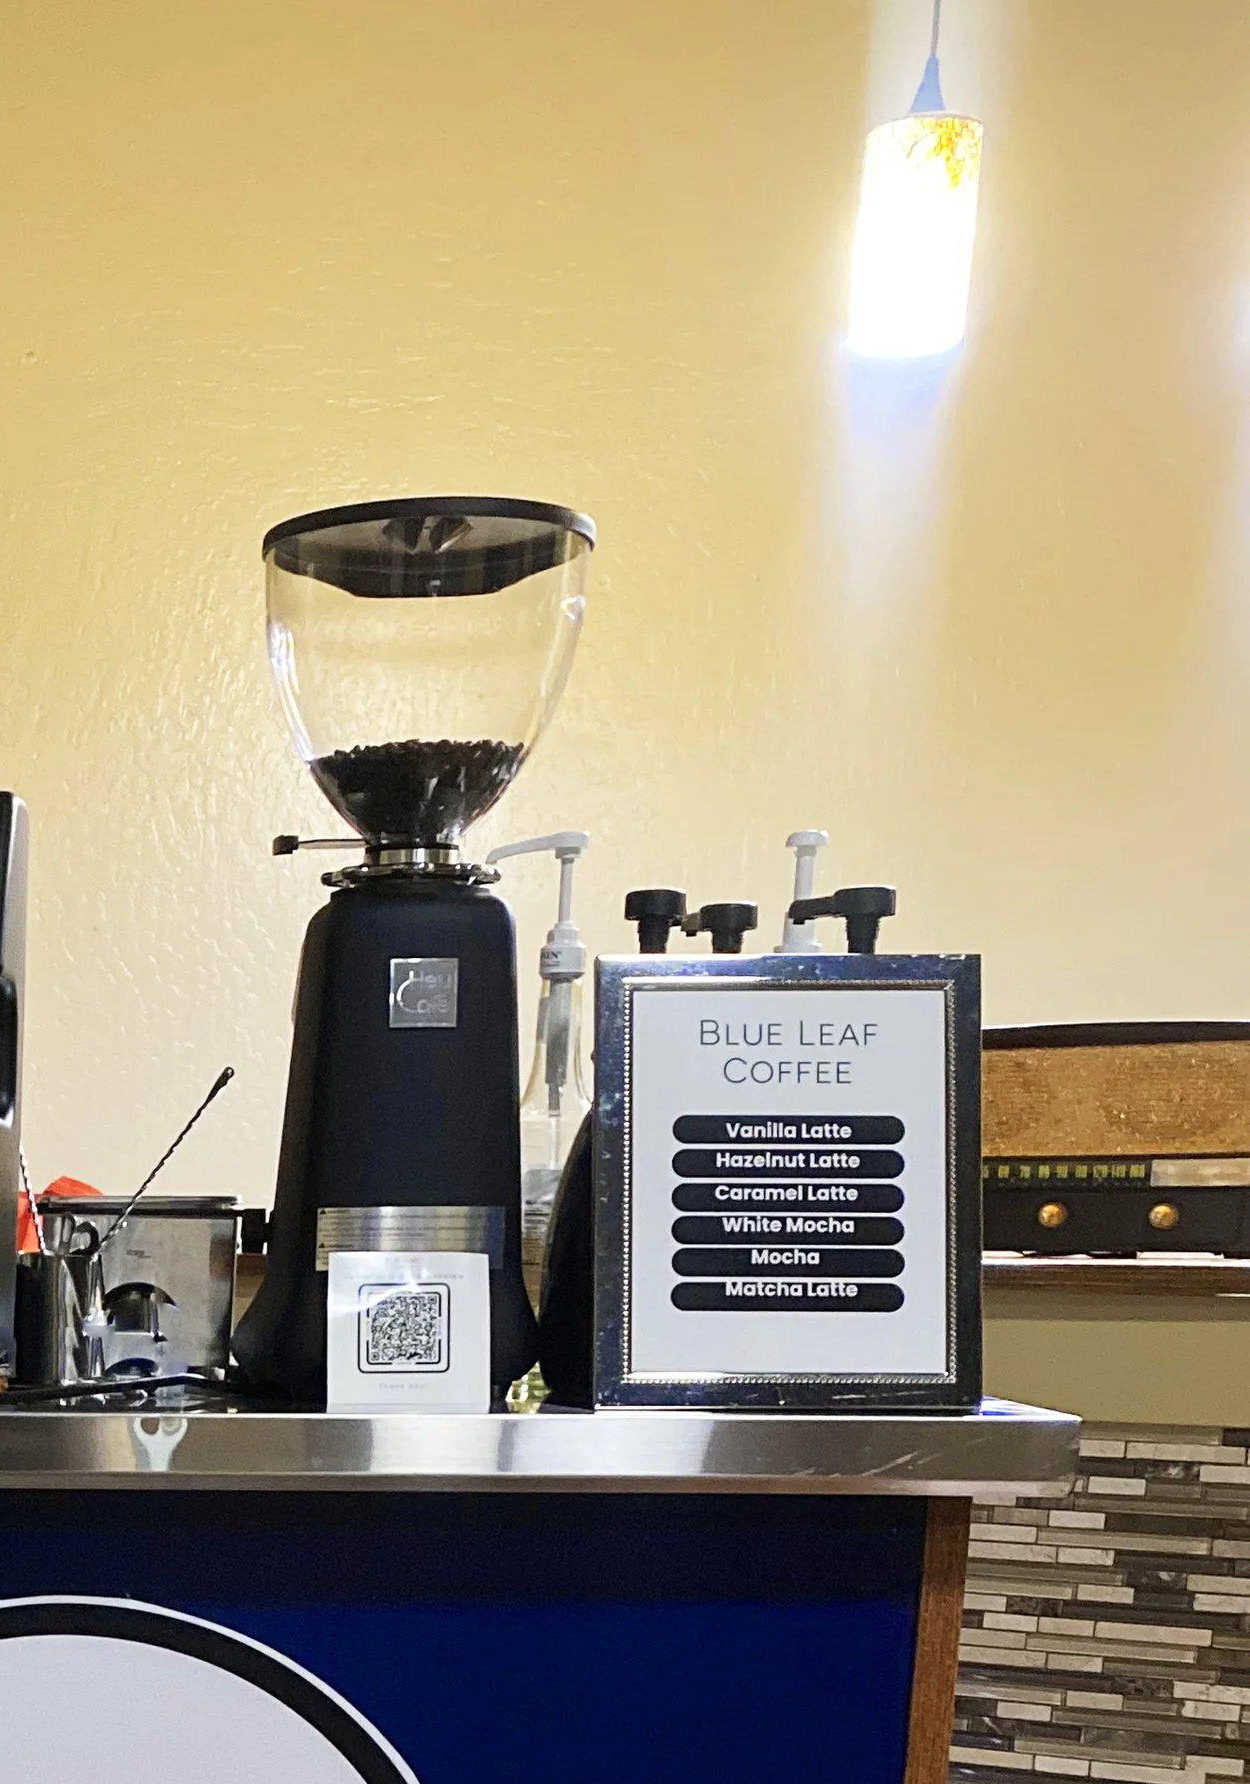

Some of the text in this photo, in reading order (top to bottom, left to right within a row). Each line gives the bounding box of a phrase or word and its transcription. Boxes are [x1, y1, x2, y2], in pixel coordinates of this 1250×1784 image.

[699, 1019, 878, 1047] BLUE LEAF
[723, 1057, 853, 1084] COFFEE
[726, 1121, 852, 1139] Vanilla Latte
[716, 1152, 861, 1169] Hazelnut Latte
[715, 1185, 859, 1201] Caramel Latte
[722, 1216, 855, 1233] White Mocha
[751, 1249, 820, 1265] Mocha
[725, 1281, 858, 1298] Matcha Latte
